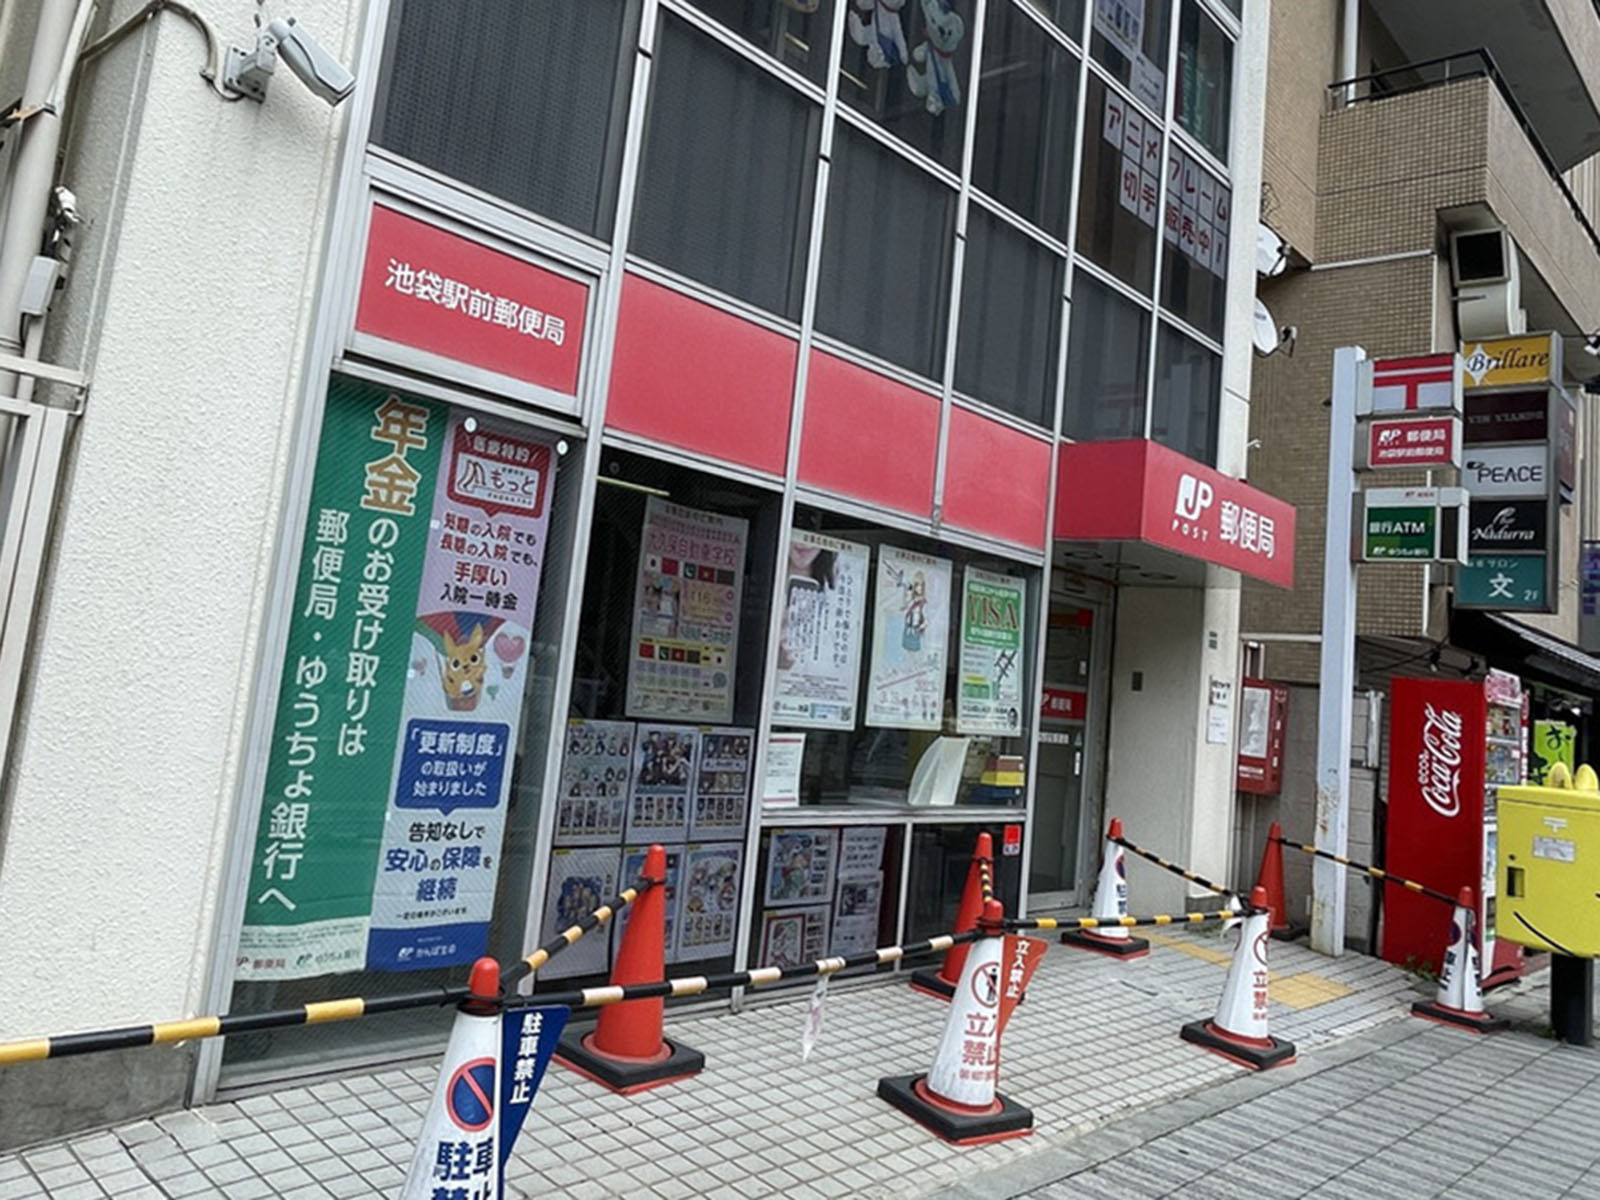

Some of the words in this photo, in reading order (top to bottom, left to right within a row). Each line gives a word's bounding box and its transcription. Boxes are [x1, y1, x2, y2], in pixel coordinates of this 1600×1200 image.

[384, 259, 566, 347] 池袋駅前郵便局
[1467, 348, 1549, 372] Brillare
[490, 469, 536, 496] もっと
[1477, 465, 1543, 483] PEACE
[1174, 473, 1214, 521] JP
[1219, 500, 1275, 559] 郵便局
[1172, 519, 1209, 542] POST
[338, 394, 431, 756] 年金のお受け取りは
[454, 560, 508, 586] 手厚い
[1488, 572, 1514, 599] 文
[440, 583, 518, 611] 入院一時金
[967, 592, 1020, 631] VISA
[258, 507, 350, 911] 郵便局・ゆうちょ銀行へ
[410, 727, 503, 758] 「更新制度」
[1422, 703, 1462, 818] Coca-Cola
[412, 780, 487, 798] 始まりました
[408, 821, 486, 843] 告知なしで
[385, 845, 492, 873] 安心の保障を
[416, 877, 458, 902] 継続
[1005, 939, 1031, 999] 立入禁止
[509, 1012, 543, 1105] 駐車禁止
